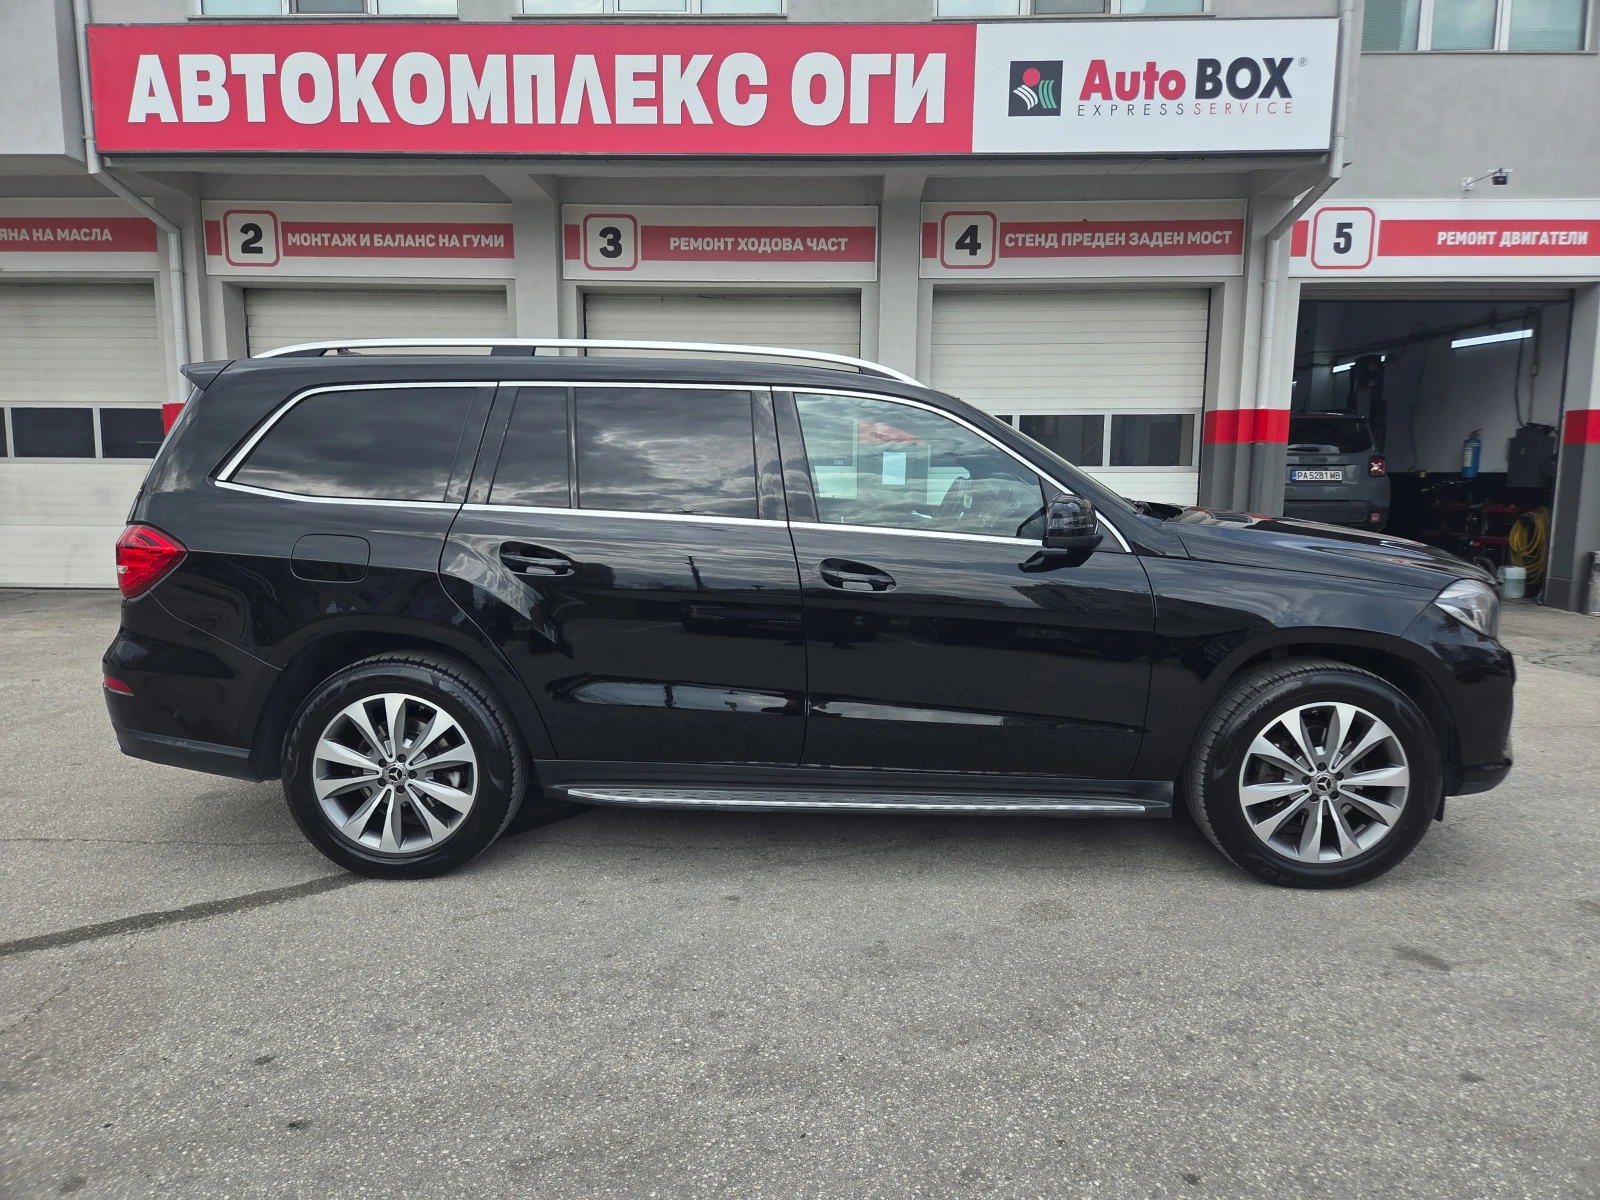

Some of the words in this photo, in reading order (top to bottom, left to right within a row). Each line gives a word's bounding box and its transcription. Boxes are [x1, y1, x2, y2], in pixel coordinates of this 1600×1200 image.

[127, 51, 769, 127] АВТОКОМПЛЕКС
[790, 51, 947, 127] ОГИ
[1079, 59, 1186, 101] Auto
[1195, 57, 1294, 100] BOX
[32, 228, 54, 242] НА
[56, 228, 113, 242] МАСЛА
[239, 222, 264, 255] 2
[287, 232, 357, 248] МОНТАЖ
[359, 233, 371, 248] И
[373, 233, 436, 248] БАЛАНС
[437, 233, 461, 248] НА
[462, 233, 505, 249] ГУМИ
[598, 226, 623, 259] 3
[669, 236, 735, 252] РЕМОНТ
[737, 236, 804, 253] ХОДОВА
[806, 236, 848, 252] ЧАСТ
[954, 224, 982, 256] 4
[1004, 232, 1059, 249] СТЕНД
[1060, 231, 1127, 249] ПРЕДЕН
[1128, 231, 1185, 248] ЗАДЕН
[1186, 229, 1233, 246] МОСТ
[1333, 222, 1355, 254] 5
[1436, 230, 1497, 246] РЕМОНТ
[1499, 230, 1589, 248] ДВИГАТЕЛИ
